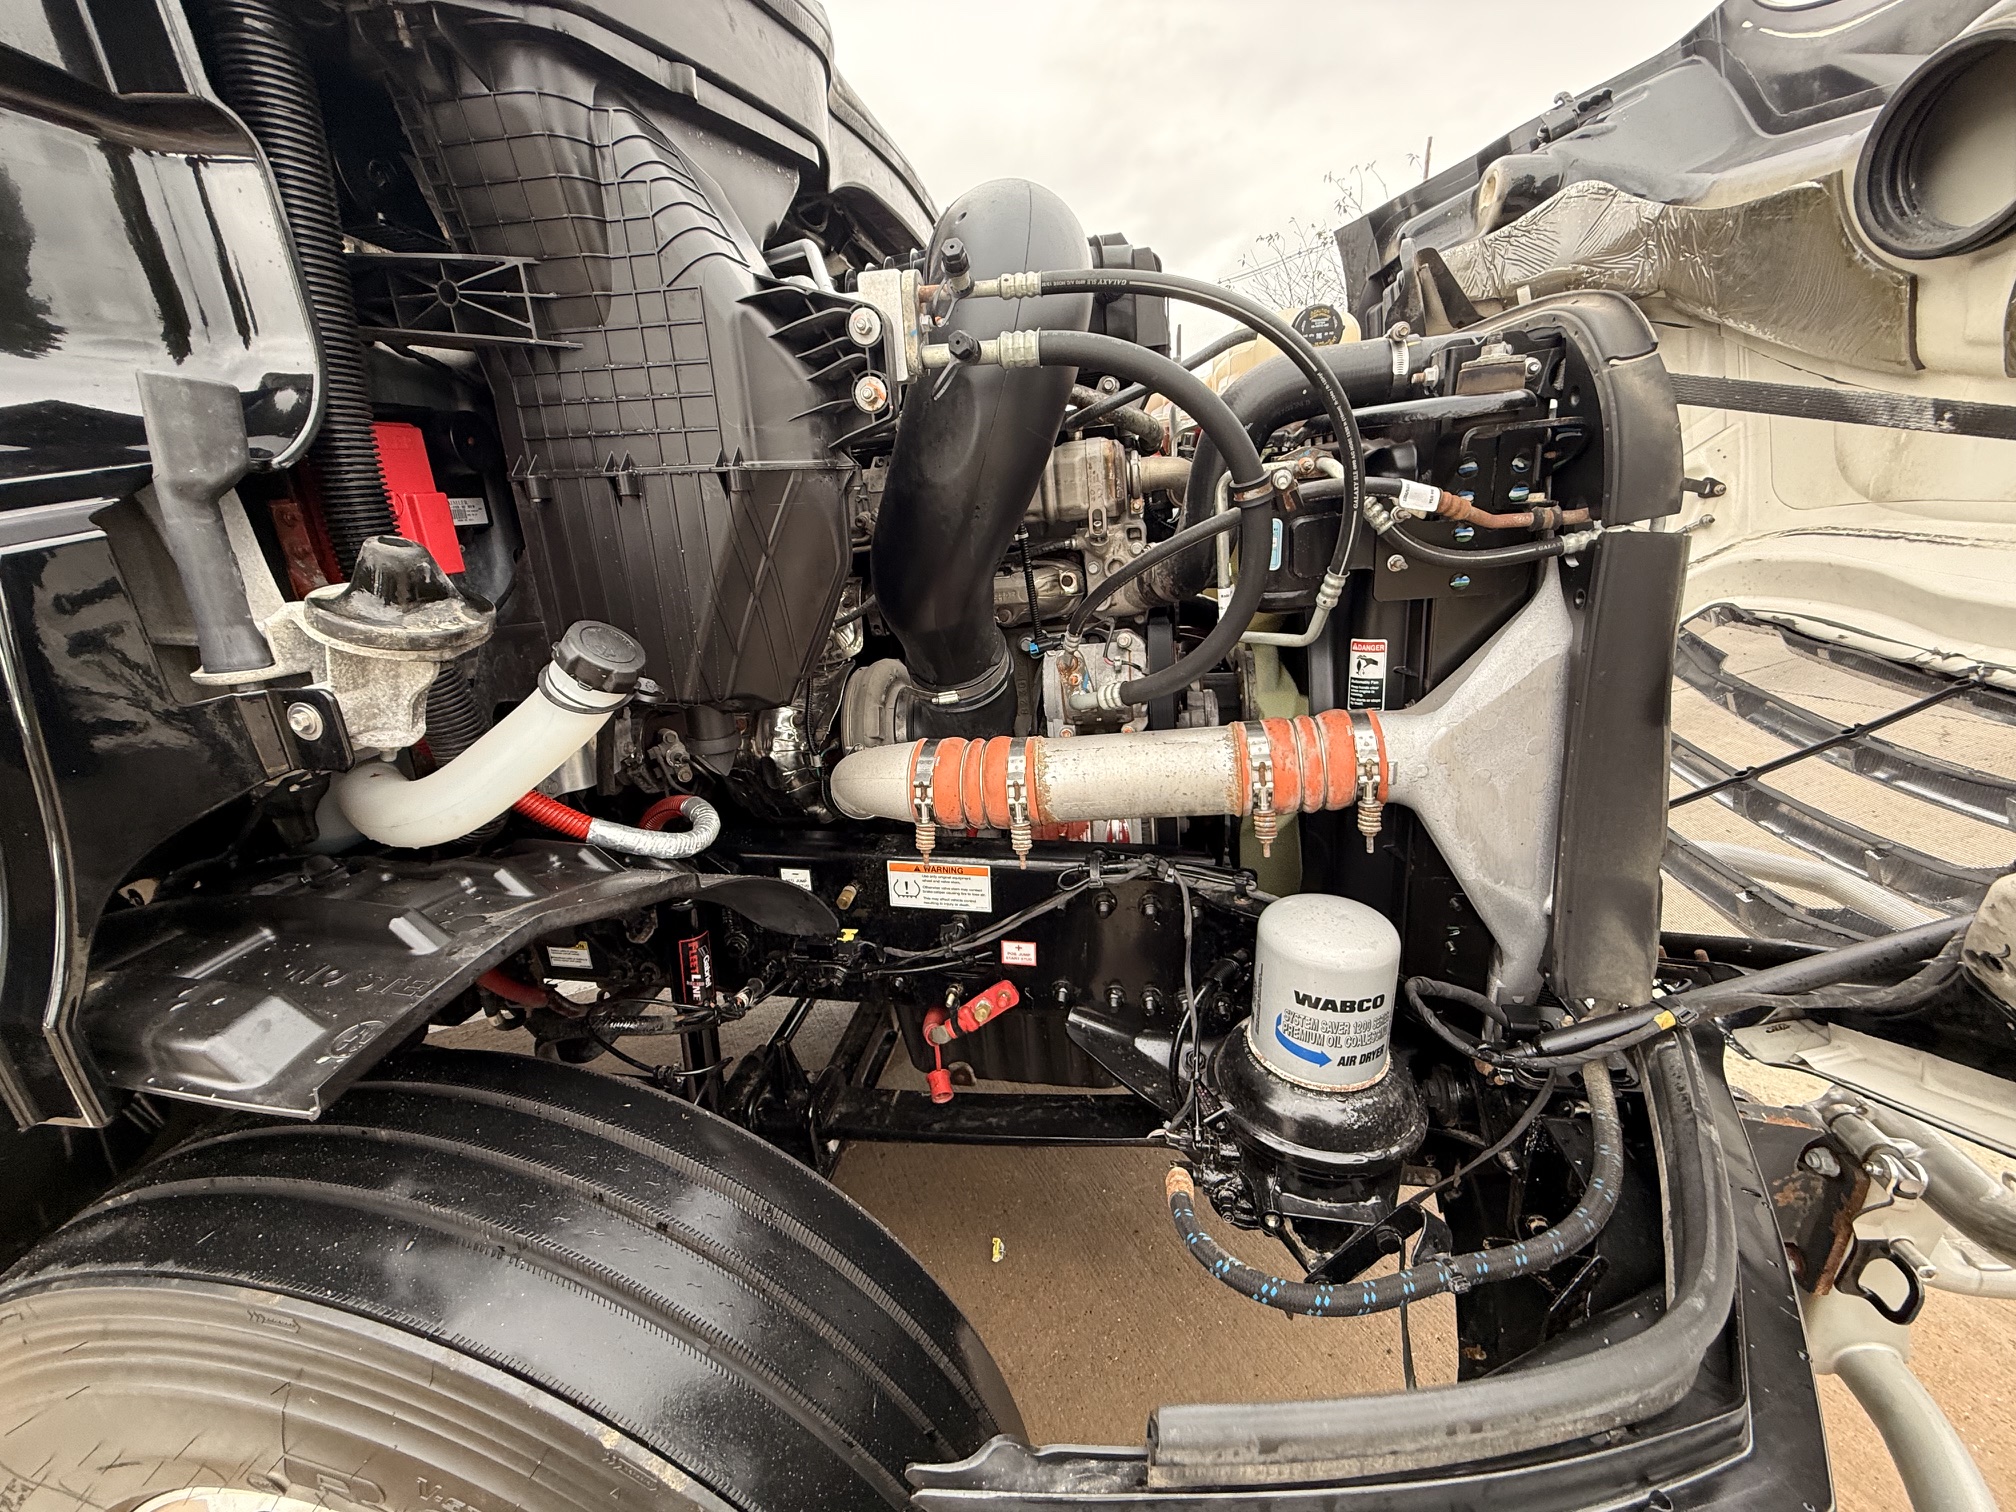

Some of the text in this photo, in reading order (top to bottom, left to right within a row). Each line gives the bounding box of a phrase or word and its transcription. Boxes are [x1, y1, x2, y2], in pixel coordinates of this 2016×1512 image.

[923, 866, 963, 874] WARNING
[688, 941, 701, 1000] FLEETLNE
[703, 955, 712, 988] Gabriel
[1294, 990, 1385, 1013] WABCO
[1282, 1021, 1324, 1047] PREMIUM
[1327, 1036, 1342, 1048] OIL
[1284, 1008, 1319, 1032] SYSTEM
[1320, 1020, 1350, 1035] SAVER
[1353, 1020, 1371, 1034] 1200
[1337, 1044, 1385, 1067] AIR DRYER
